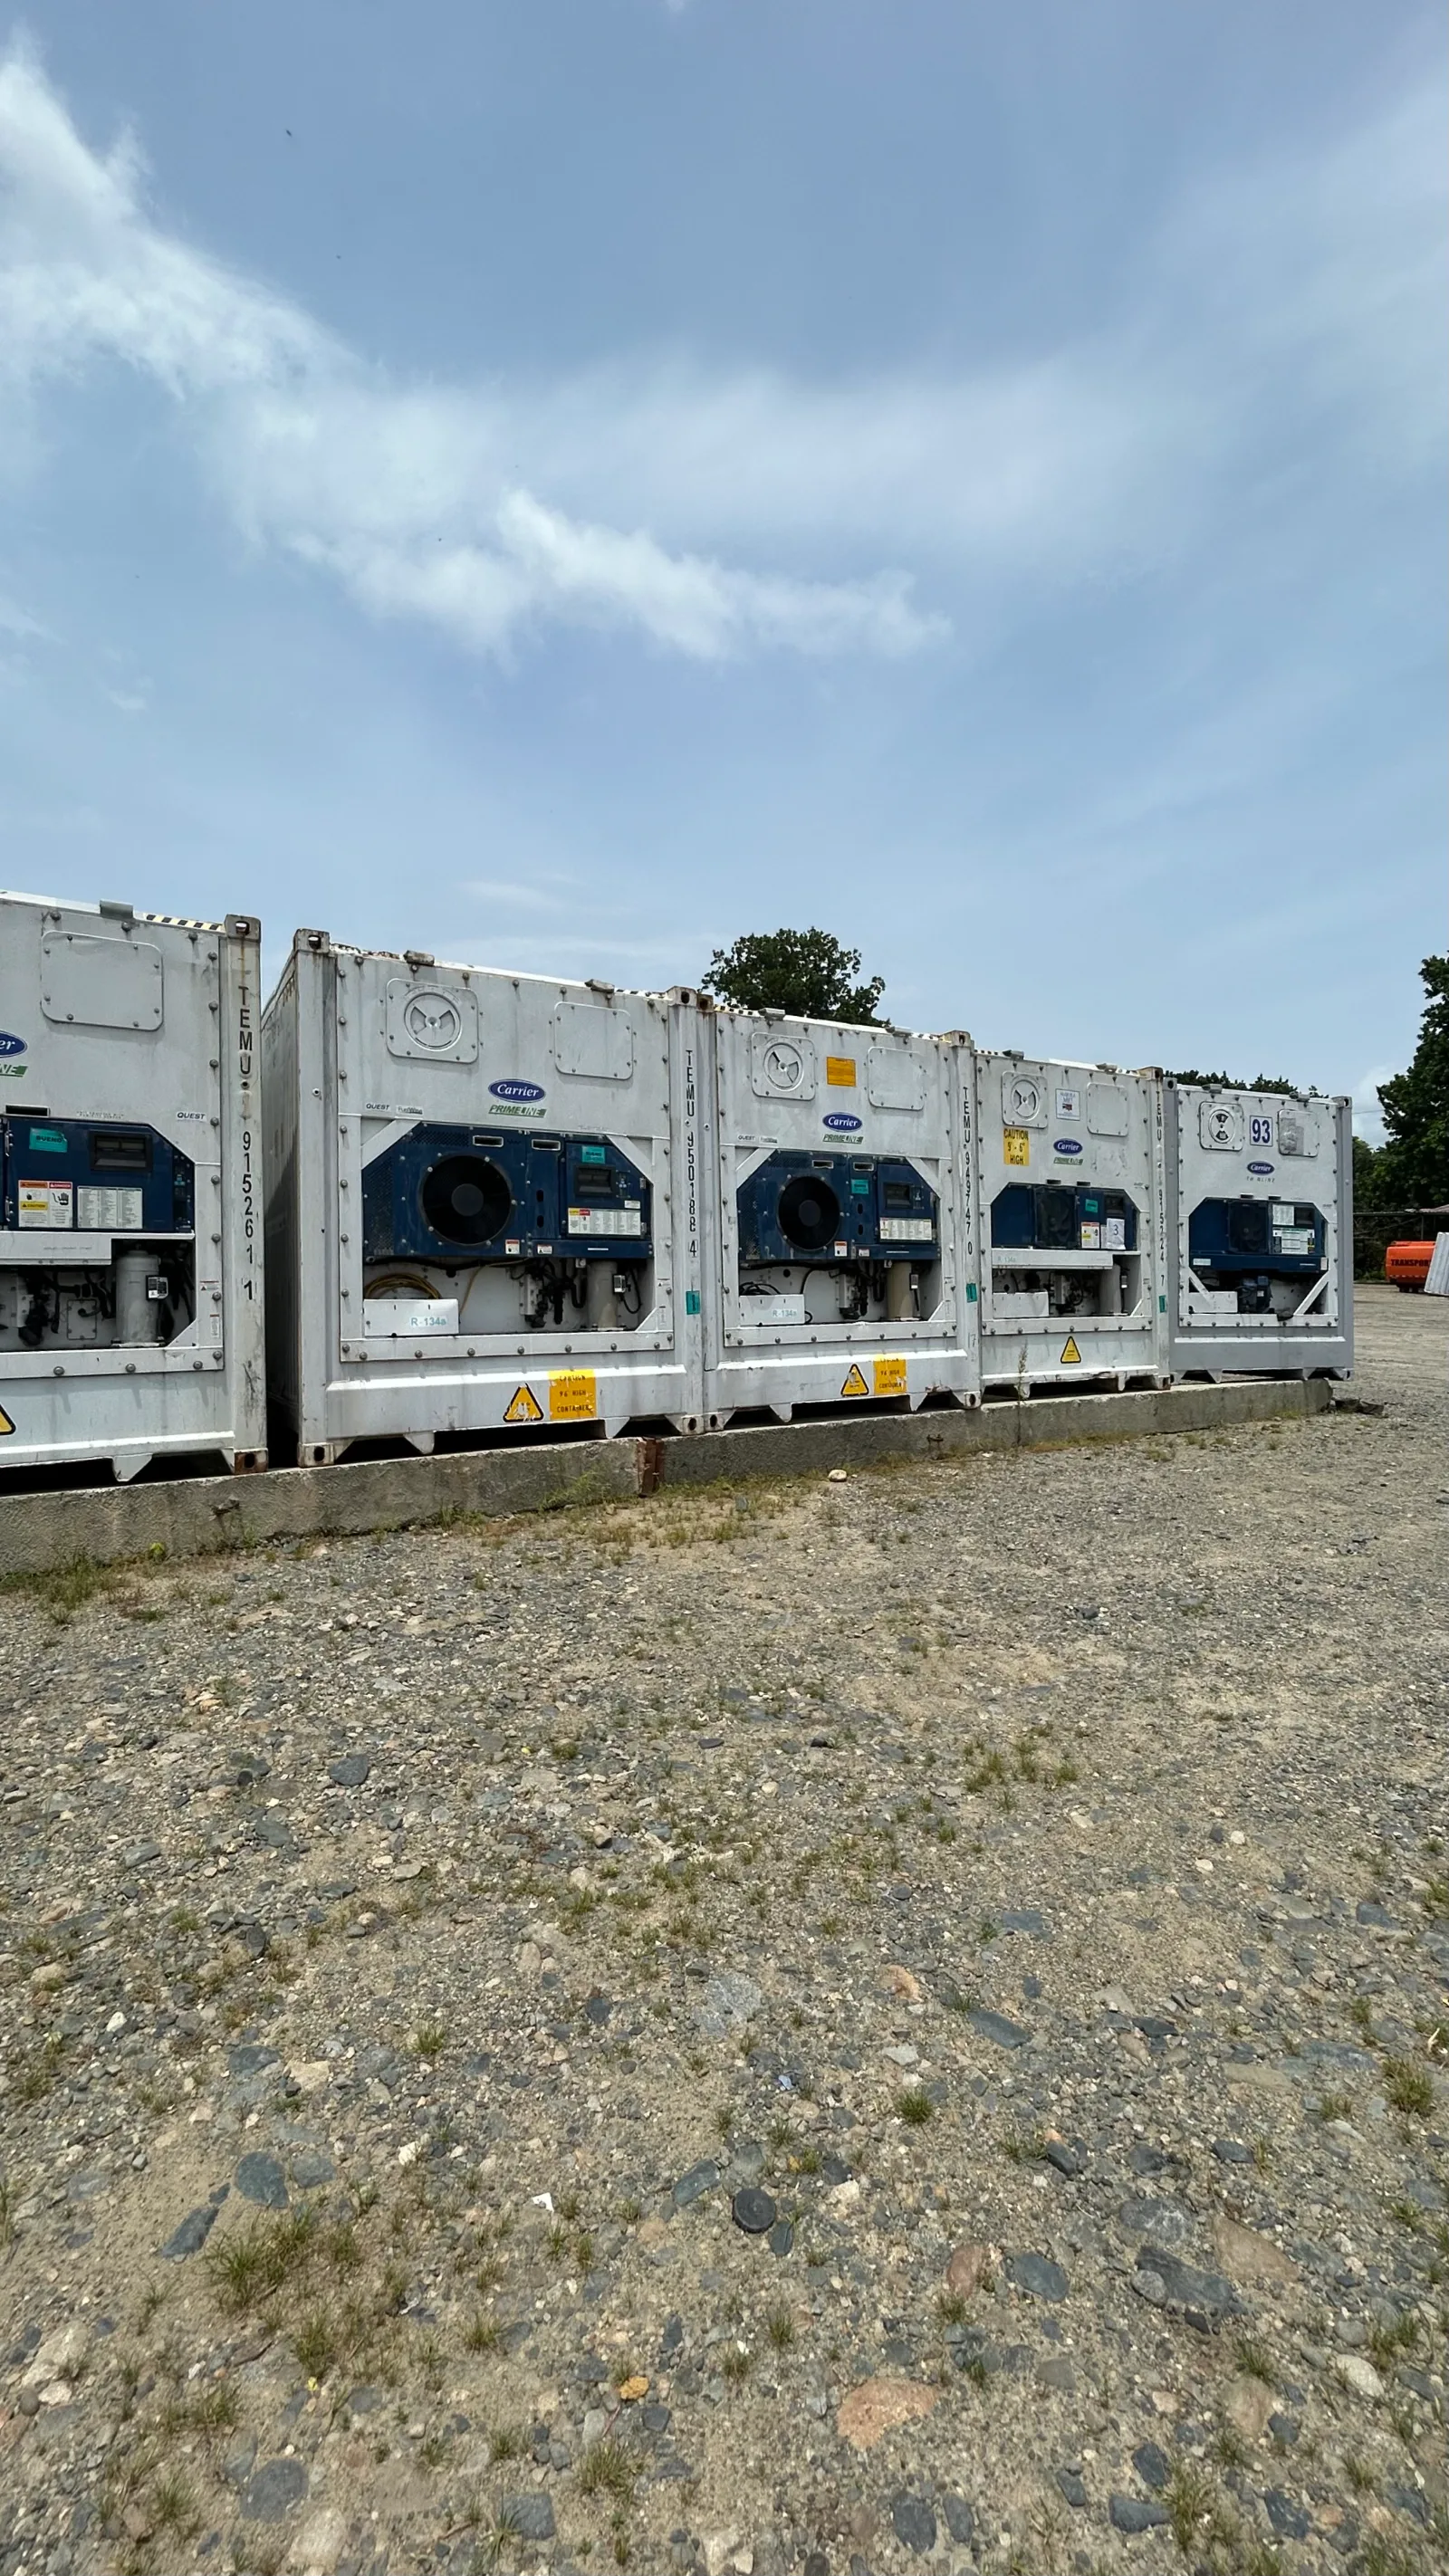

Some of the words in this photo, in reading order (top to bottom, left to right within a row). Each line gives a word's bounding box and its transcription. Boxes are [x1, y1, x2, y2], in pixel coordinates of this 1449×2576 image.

[238, 986, 253, 1075] TEMU
[497, 1083, 540, 1097] Carrier
[686, 1049, 695, 1117] TEMU
[177, 1111, 206, 1120] QUEST
[489, 1105, 545, 1117] PRIMELINE
[828, 1116, 859, 1127] Carrier
[1003, 1128, 1029, 1141] CAUTION
[1252, 1119, 1271, 1144] 93
[1057, 1142, 1080, 1151] Carrier
[1010, 1154, 1024, 1165] HIGH
[963, 1087, 971, 1144] TEMU
[967, 1241, 973, 1255] 0
[242, 1131, 253, 1264] 915261
[1114, 1224, 1119, 1236] 3
[688, 1240, 696, 1257] 4
[244, 1279, 253, 1300] 1
